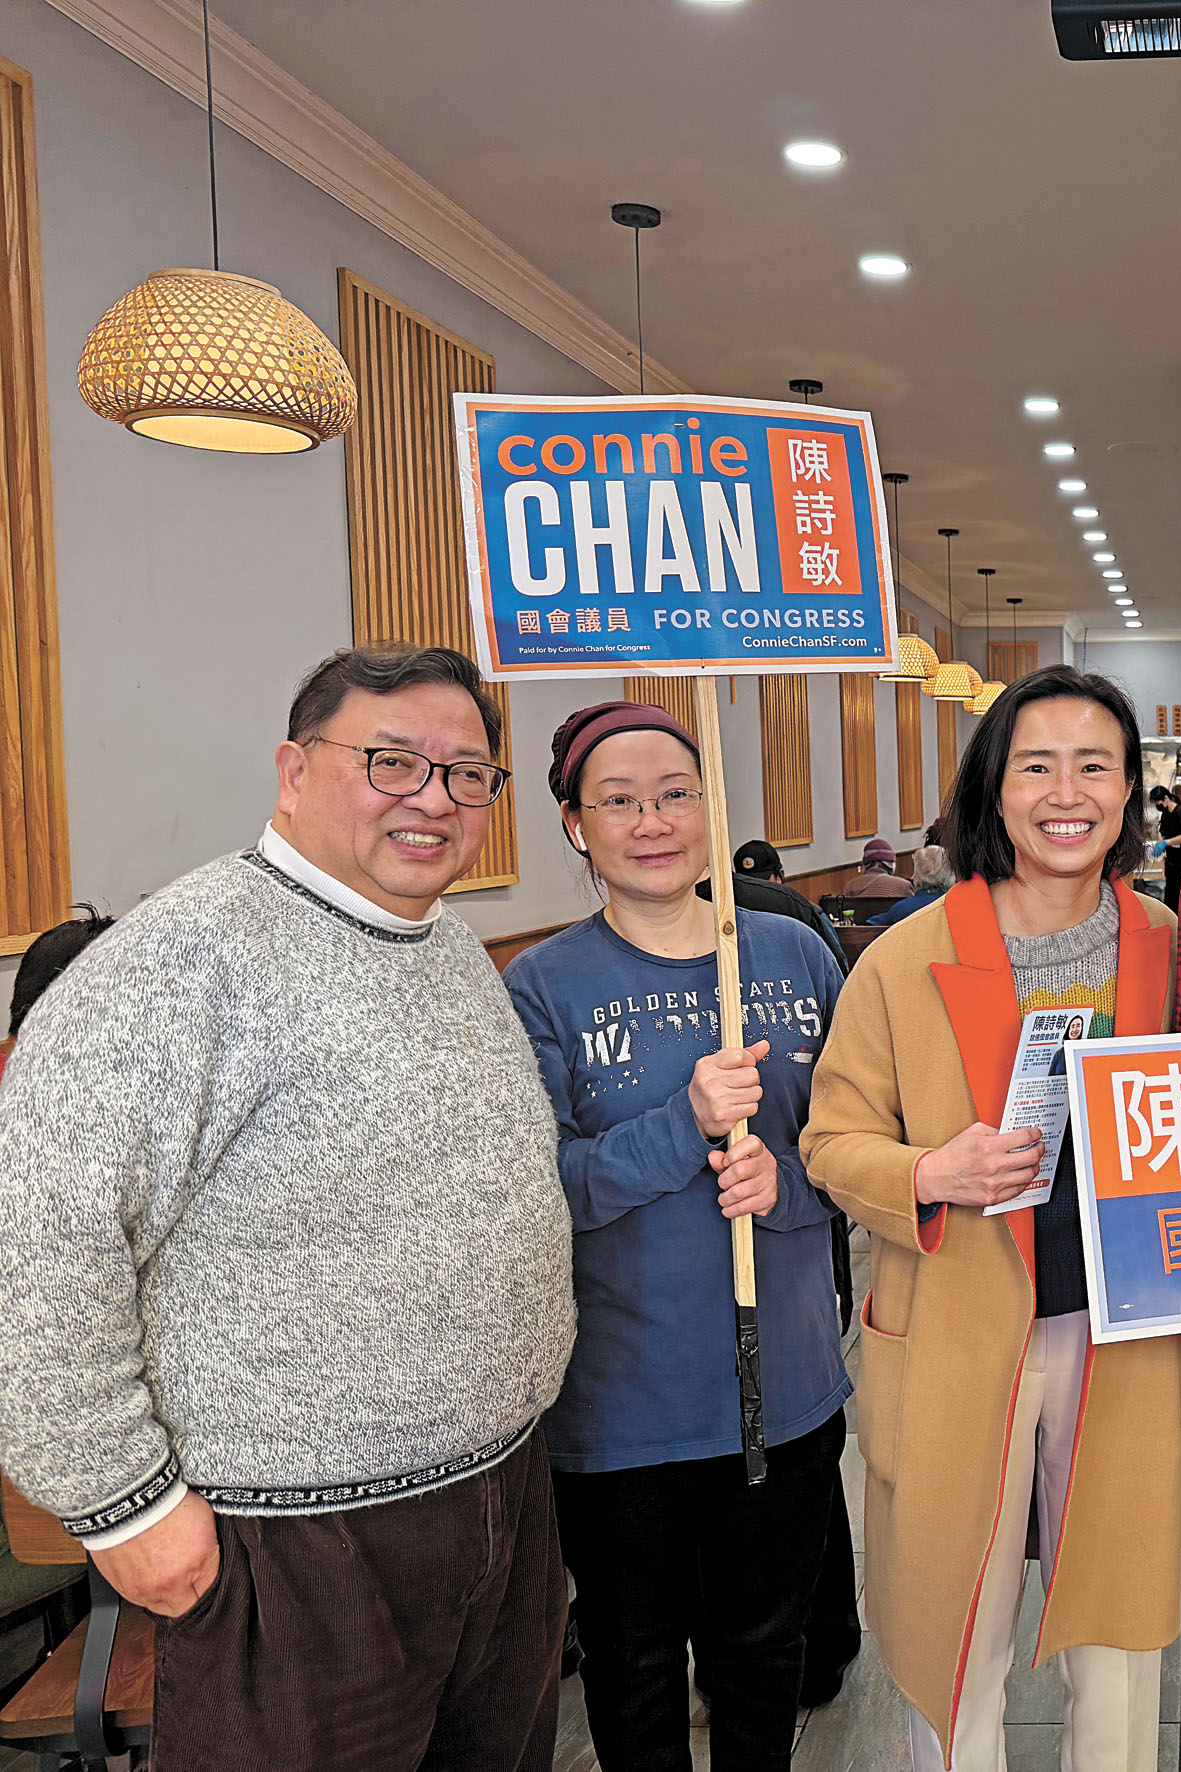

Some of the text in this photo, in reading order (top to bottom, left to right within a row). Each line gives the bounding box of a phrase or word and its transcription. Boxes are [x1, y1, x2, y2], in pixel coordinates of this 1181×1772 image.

[498, 417, 748, 475] connie
[788, 438, 843, 587] 陳詩敏
[504, 480, 761, 596] CHAN
[516, 607, 631, 635] 國會議員
[653, 608, 866, 630] FOR CONGRESS
[536, 646, 547, 654] for
[547, 646, 557, 654] by
[558, 645, 584, 653] Connie
[616, 644, 651, 652] Congress
[742, 635, 868, 648] ConnieChanSF.com
[593, 979, 793, 1025] GOLDEN SATE
[1032, 1014, 1068, 1031] 陳詩敏
